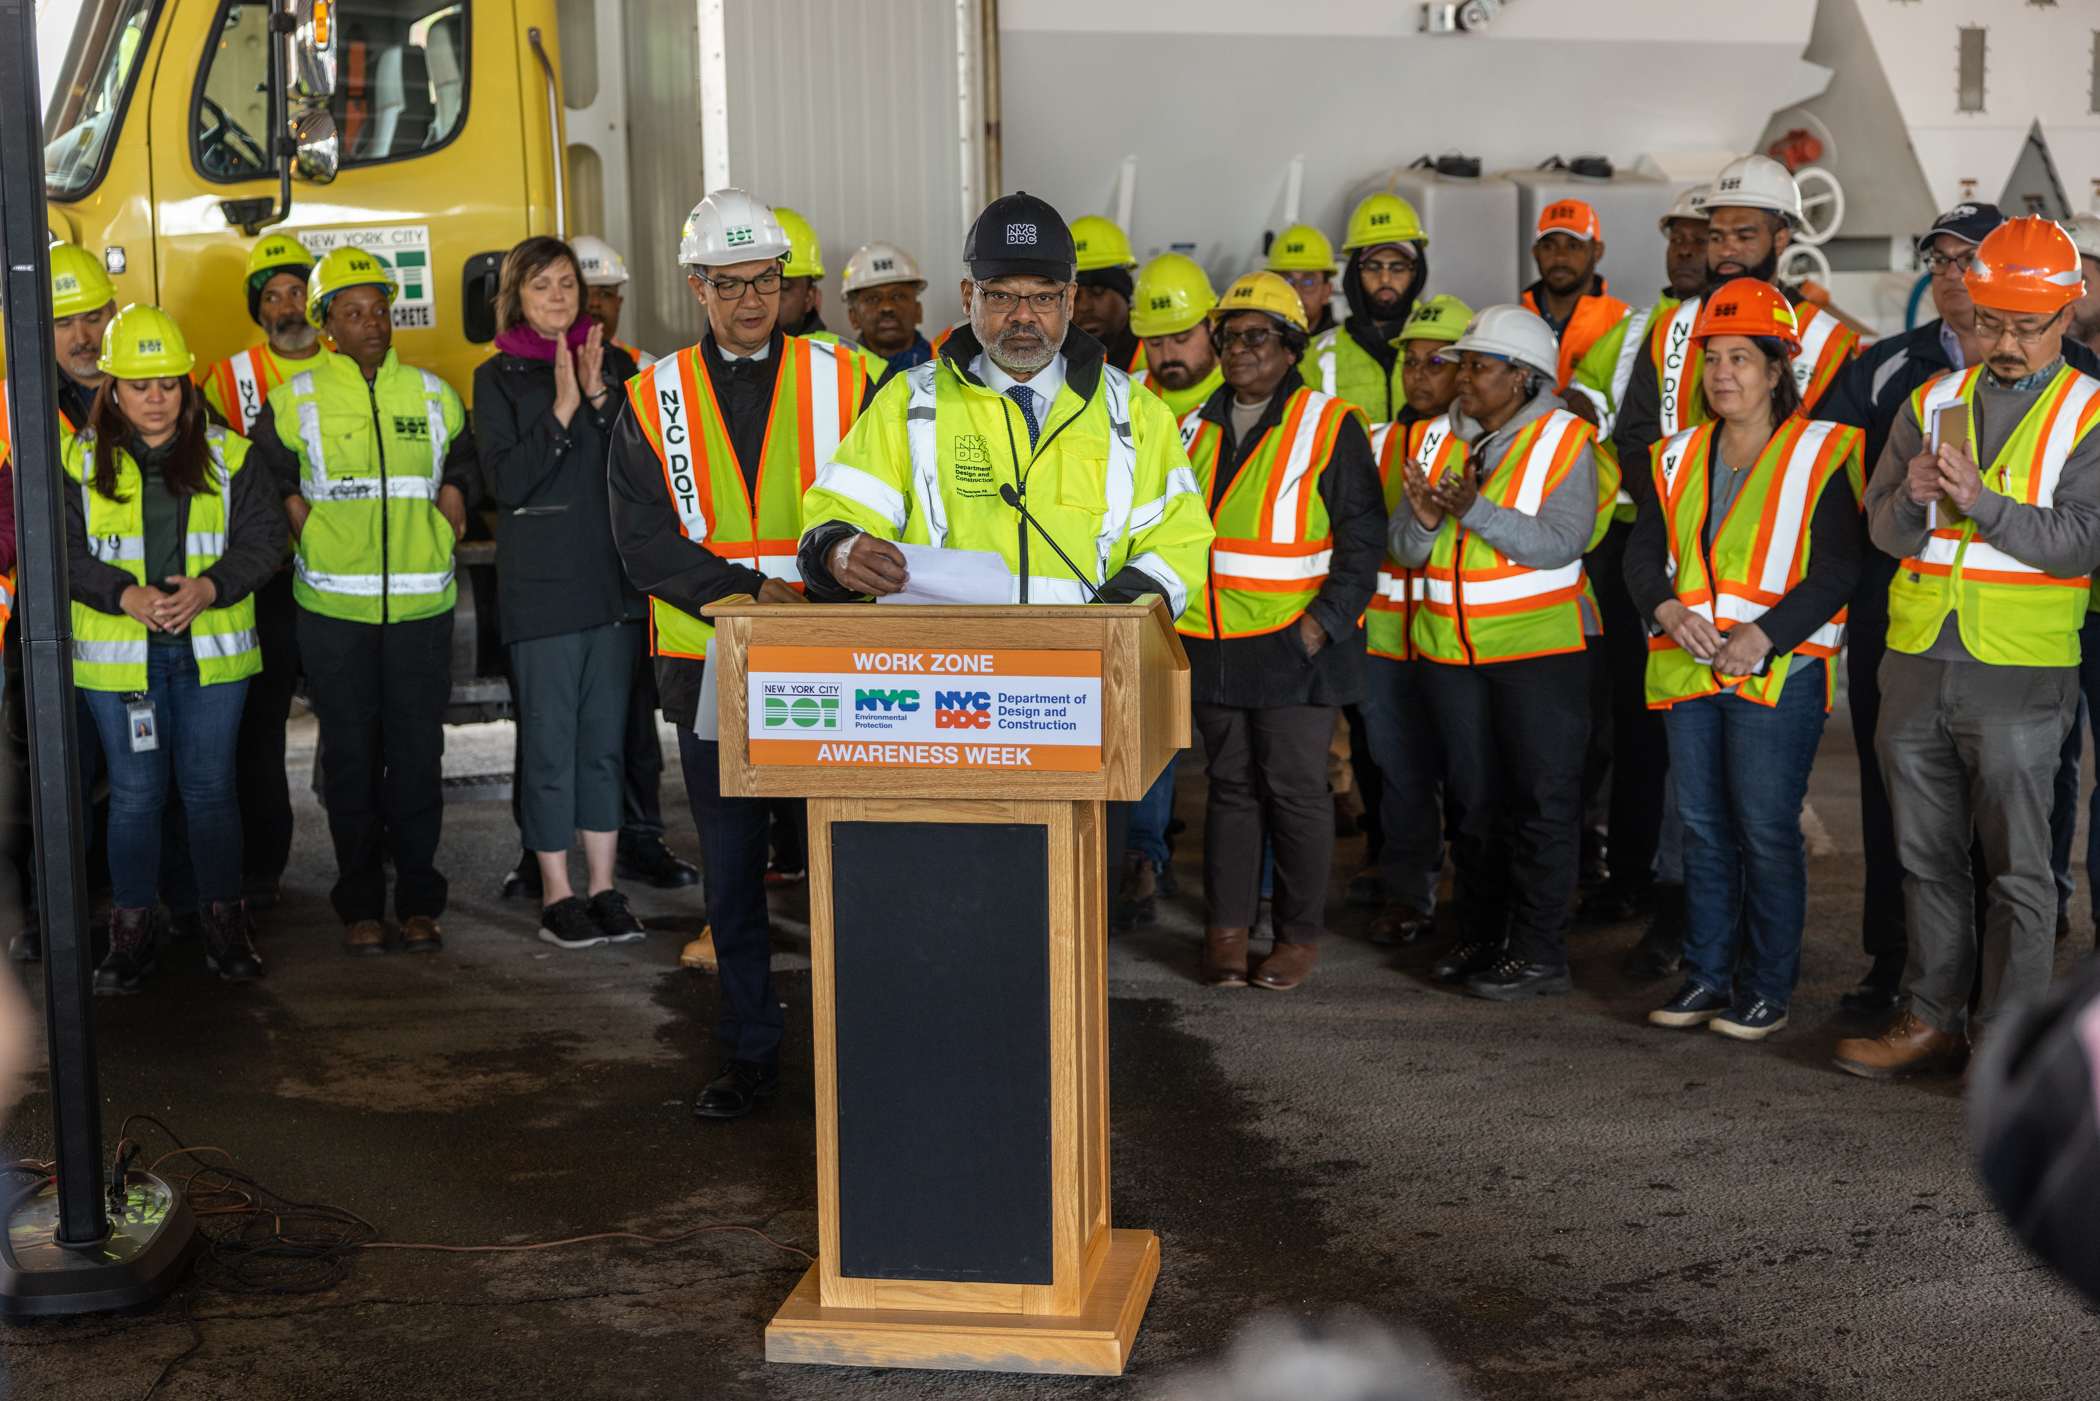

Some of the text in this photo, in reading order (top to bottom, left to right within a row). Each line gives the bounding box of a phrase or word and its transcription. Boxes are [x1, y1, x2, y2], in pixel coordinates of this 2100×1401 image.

[1720, 179, 1741, 190] DOT
[1371, 215, 1390, 225] DOT
[727, 229, 752, 242] DOT
[1007, 224, 1037, 235] NYC
[302, 229, 423, 247] NEW YORK CITY
[1007, 234, 1037, 245] DDC
[392, 307, 429, 326] CRETE
[1715, 304, 1738, 317] DOT
[1663, 322, 1689, 429] NYC DOT
[240, 379, 258, 418] NYC
[396, 421, 427, 434] DOT
[660, 389, 695, 514] NYC DOT
[955, 464, 991, 472] Department
[956, 470, 976, 478] Design
[956, 475, 993, 483] Construction
[853, 653, 994, 672] WORK ZONE
[765, 685, 839, 694] NEW YORK CITY
[855, 689, 920, 712] NYC
[935, 691, 991, 711] NYC
[998, 693, 1087, 705] Department of
[765, 697, 839, 728] DOT
[998, 706, 1067, 718] Design and
[935, 709, 991, 729] DDC
[998, 719, 1077, 730] Construction
[817, 744, 1032, 766] AWARENESS WEEK
